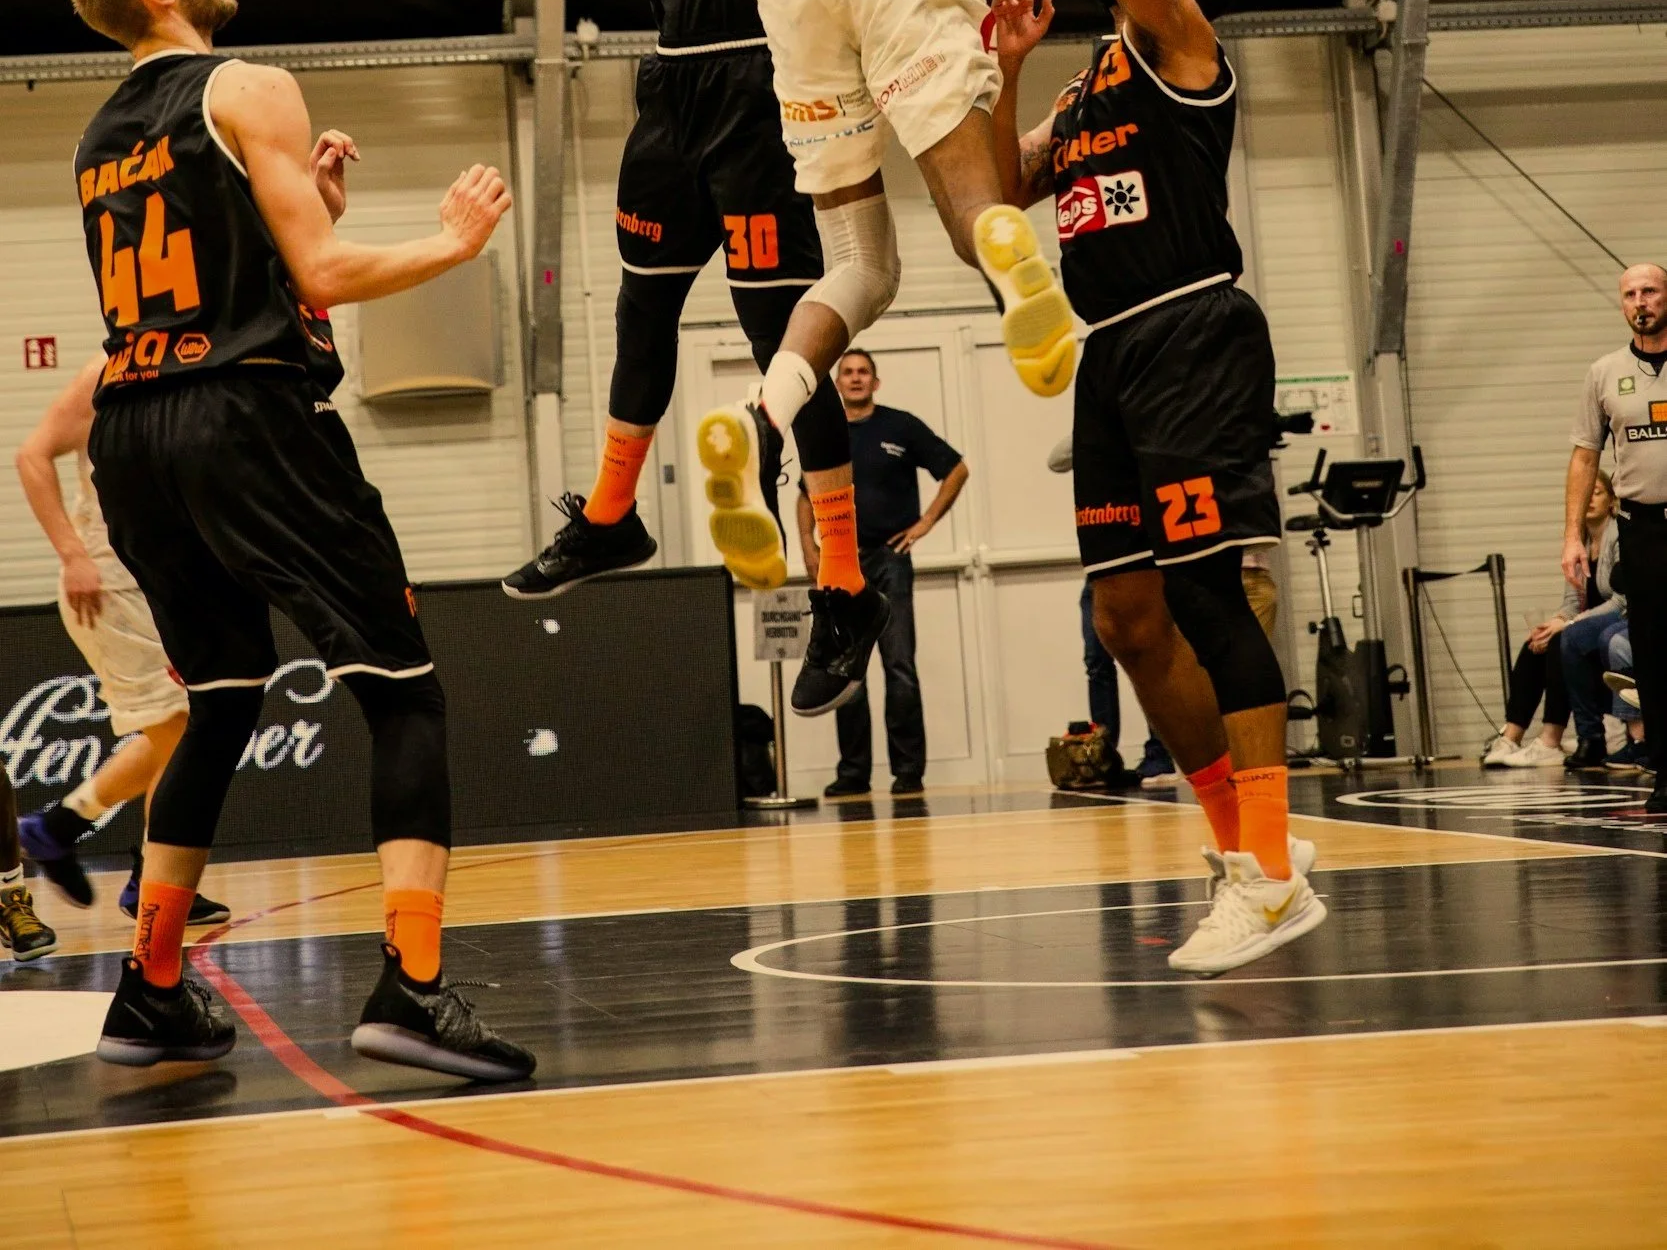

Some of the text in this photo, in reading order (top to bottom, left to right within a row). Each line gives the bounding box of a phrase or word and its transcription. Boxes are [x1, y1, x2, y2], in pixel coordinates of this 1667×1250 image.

[100, 192, 200, 328] 44
[723, 213, 779, 269] 30
[140, 369, 159, 382] you
[1627, 426, 1667, 440] BALL
[1155, 476, 1222, 543] 23
